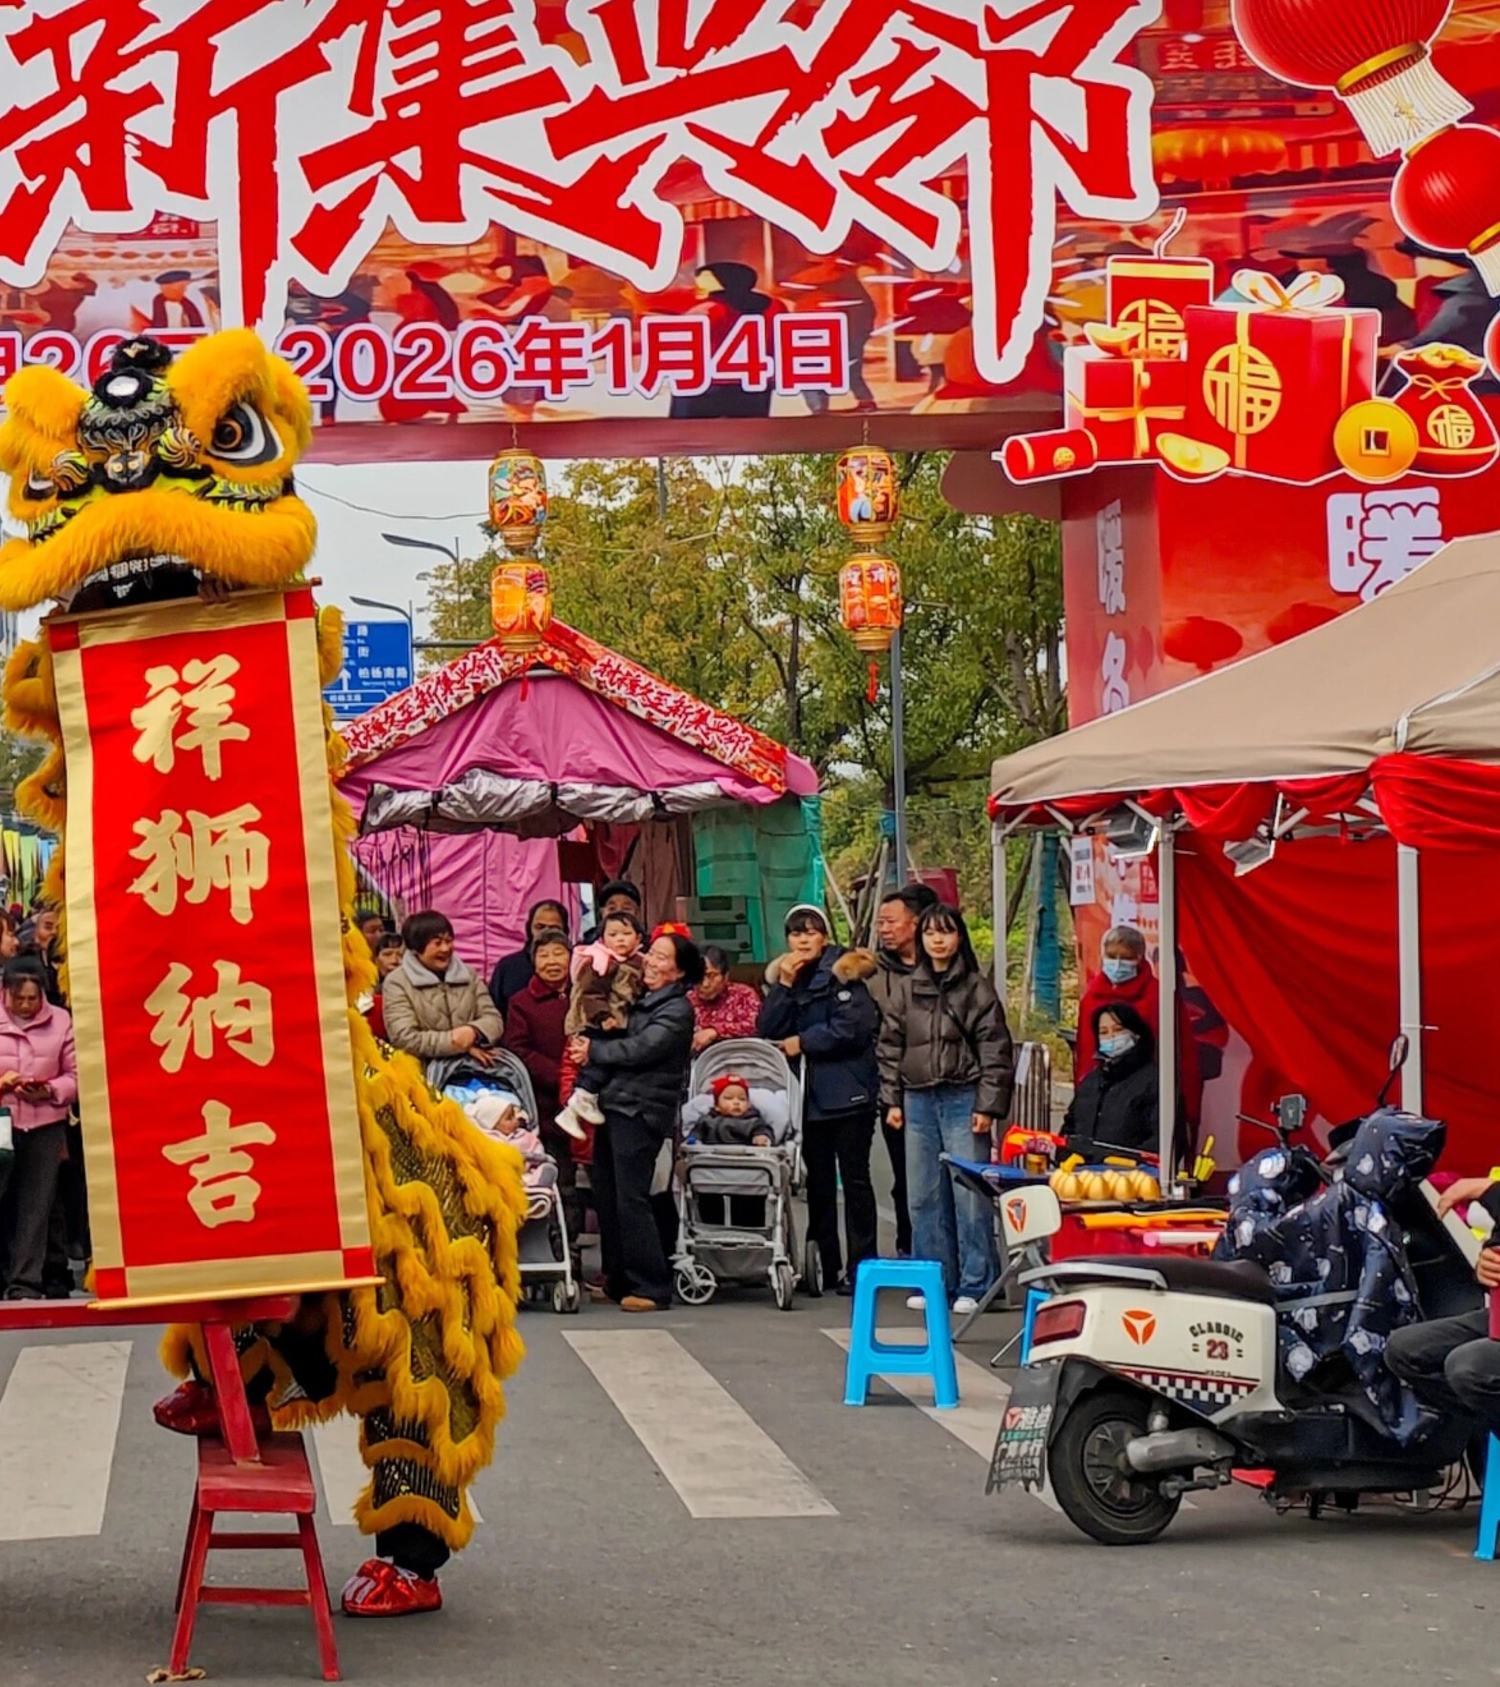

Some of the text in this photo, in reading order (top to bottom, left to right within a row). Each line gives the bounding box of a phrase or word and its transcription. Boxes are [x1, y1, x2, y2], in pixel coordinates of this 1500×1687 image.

[1117, 299, 1184, 357] 福
[1203, 344, 1281, 434] 福
[1426, 404, 1475, 448] 福
[1327, 486, 1445, 602] 暖
[125, 653, 278, 1228] 祥狮纳吉
[1188, 1321, 1244, 1343] CLASSIC
[1206, 1338, 1229, 1361] 23
